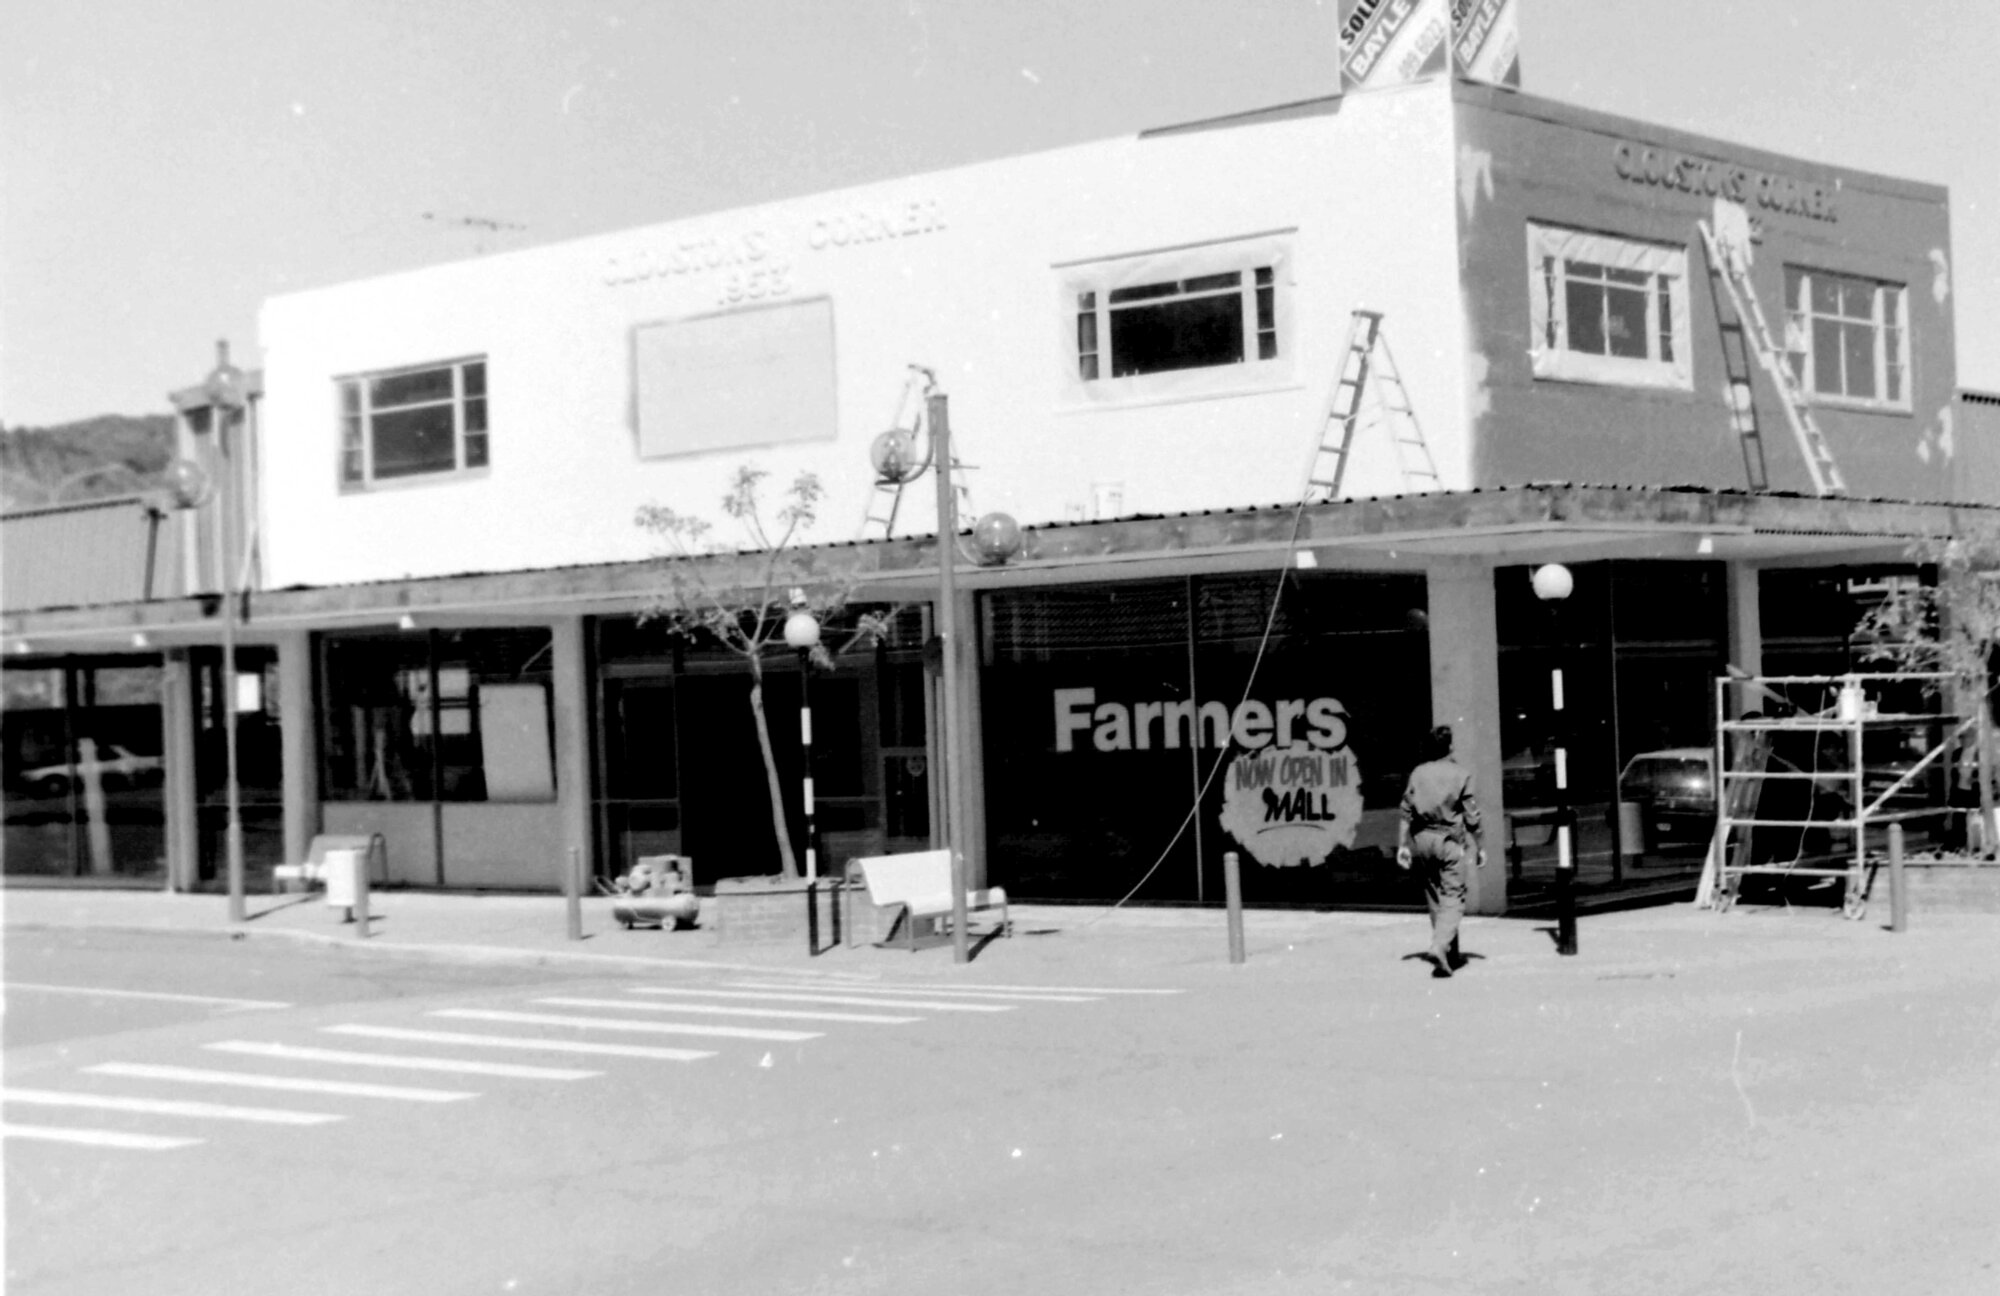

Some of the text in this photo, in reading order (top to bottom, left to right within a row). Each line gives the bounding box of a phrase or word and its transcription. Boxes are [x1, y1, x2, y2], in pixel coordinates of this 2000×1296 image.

[1459, 0, 1502, 64] BAYLE
[1054, 687, 1347, 752] Farmers
[1235, 755, 1348, 791] NOW OPEN IN
[1262, 787, 1336, 822] MALL
